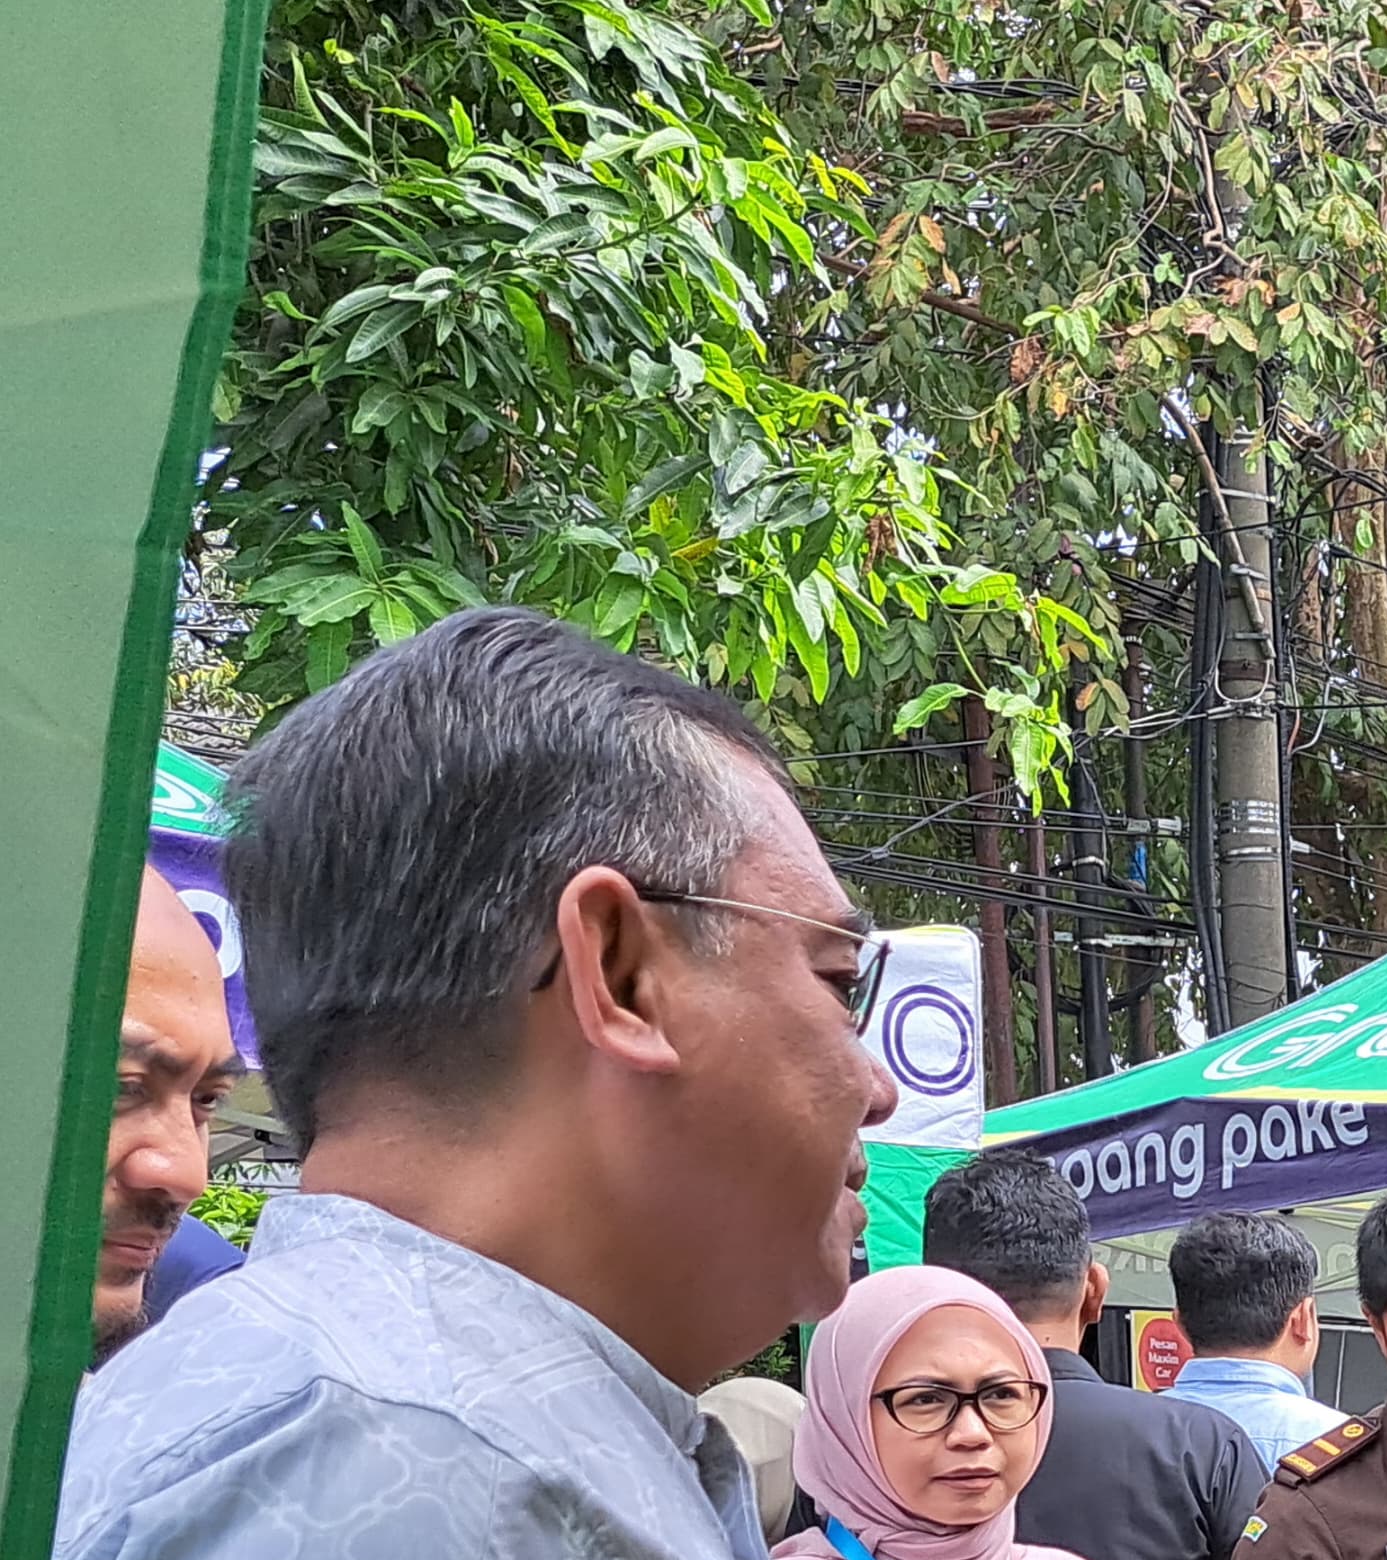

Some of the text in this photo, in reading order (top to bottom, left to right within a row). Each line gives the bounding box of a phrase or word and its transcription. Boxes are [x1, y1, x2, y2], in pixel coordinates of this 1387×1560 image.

[1221, 1100, 1370, 1189] pake
[1149, 1337, 1178, 1351] Pesan
[1155, 1366, 1172, 1379] Car
